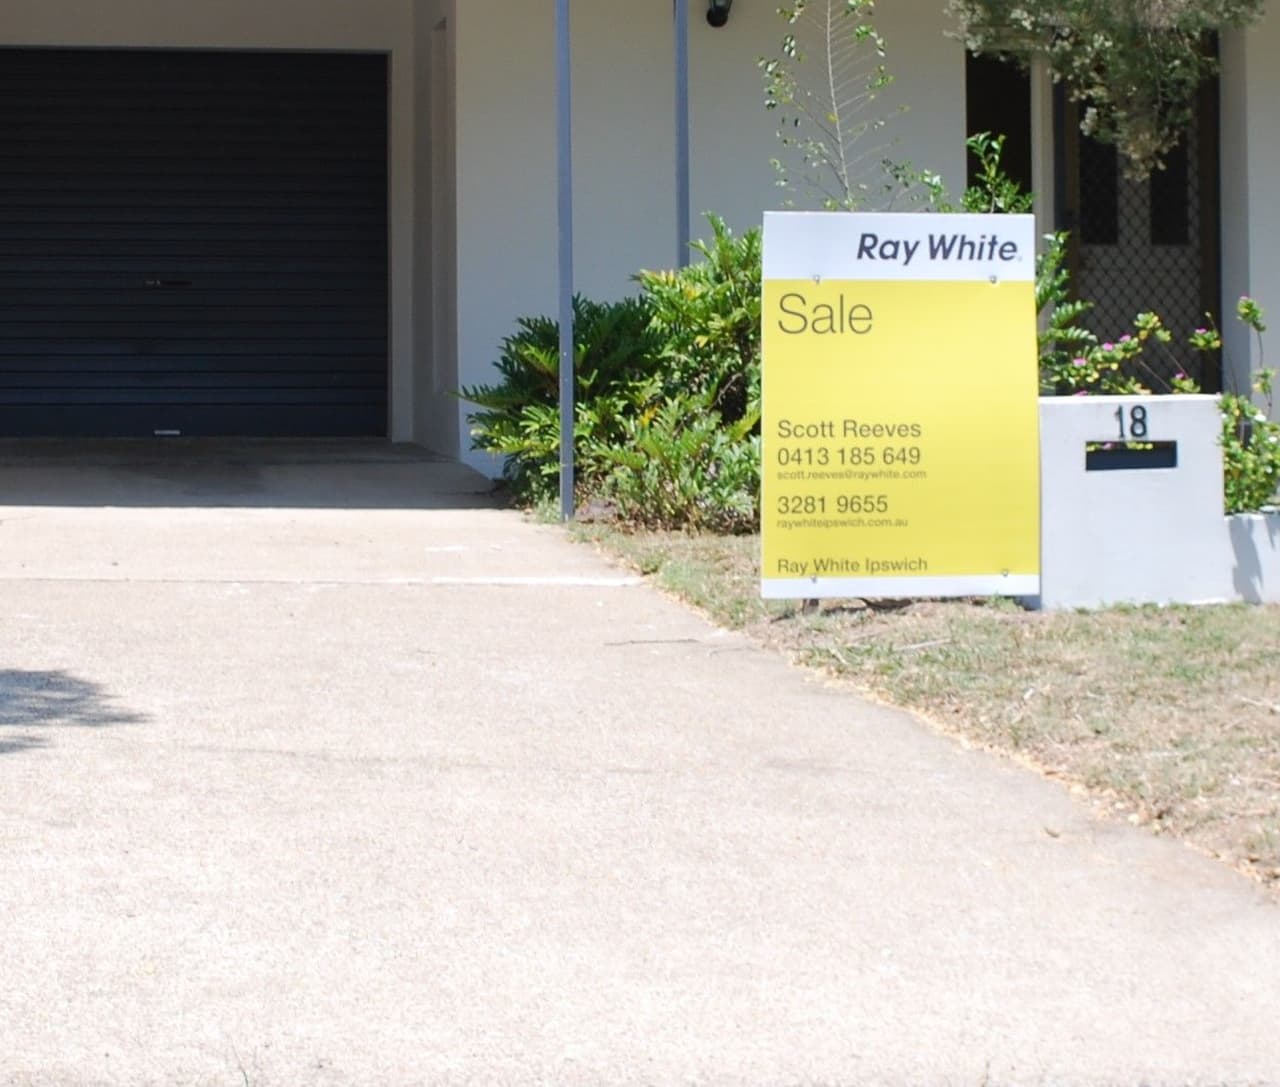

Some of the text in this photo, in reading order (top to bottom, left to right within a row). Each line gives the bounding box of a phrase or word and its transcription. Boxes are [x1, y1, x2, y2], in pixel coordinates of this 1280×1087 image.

[857, 233, 1019, 266] Ray White
[777, 293, 873, 335] Sale
[777, 419, 922, 439] Scott Reeves
[1115, 405, 1148, 438] 18
[777, 446, 921, 466] 0413 185 649
[777, 495, 889, 514] 3281 9655
[777, 557, 928, 576] Ray White Ipswich
